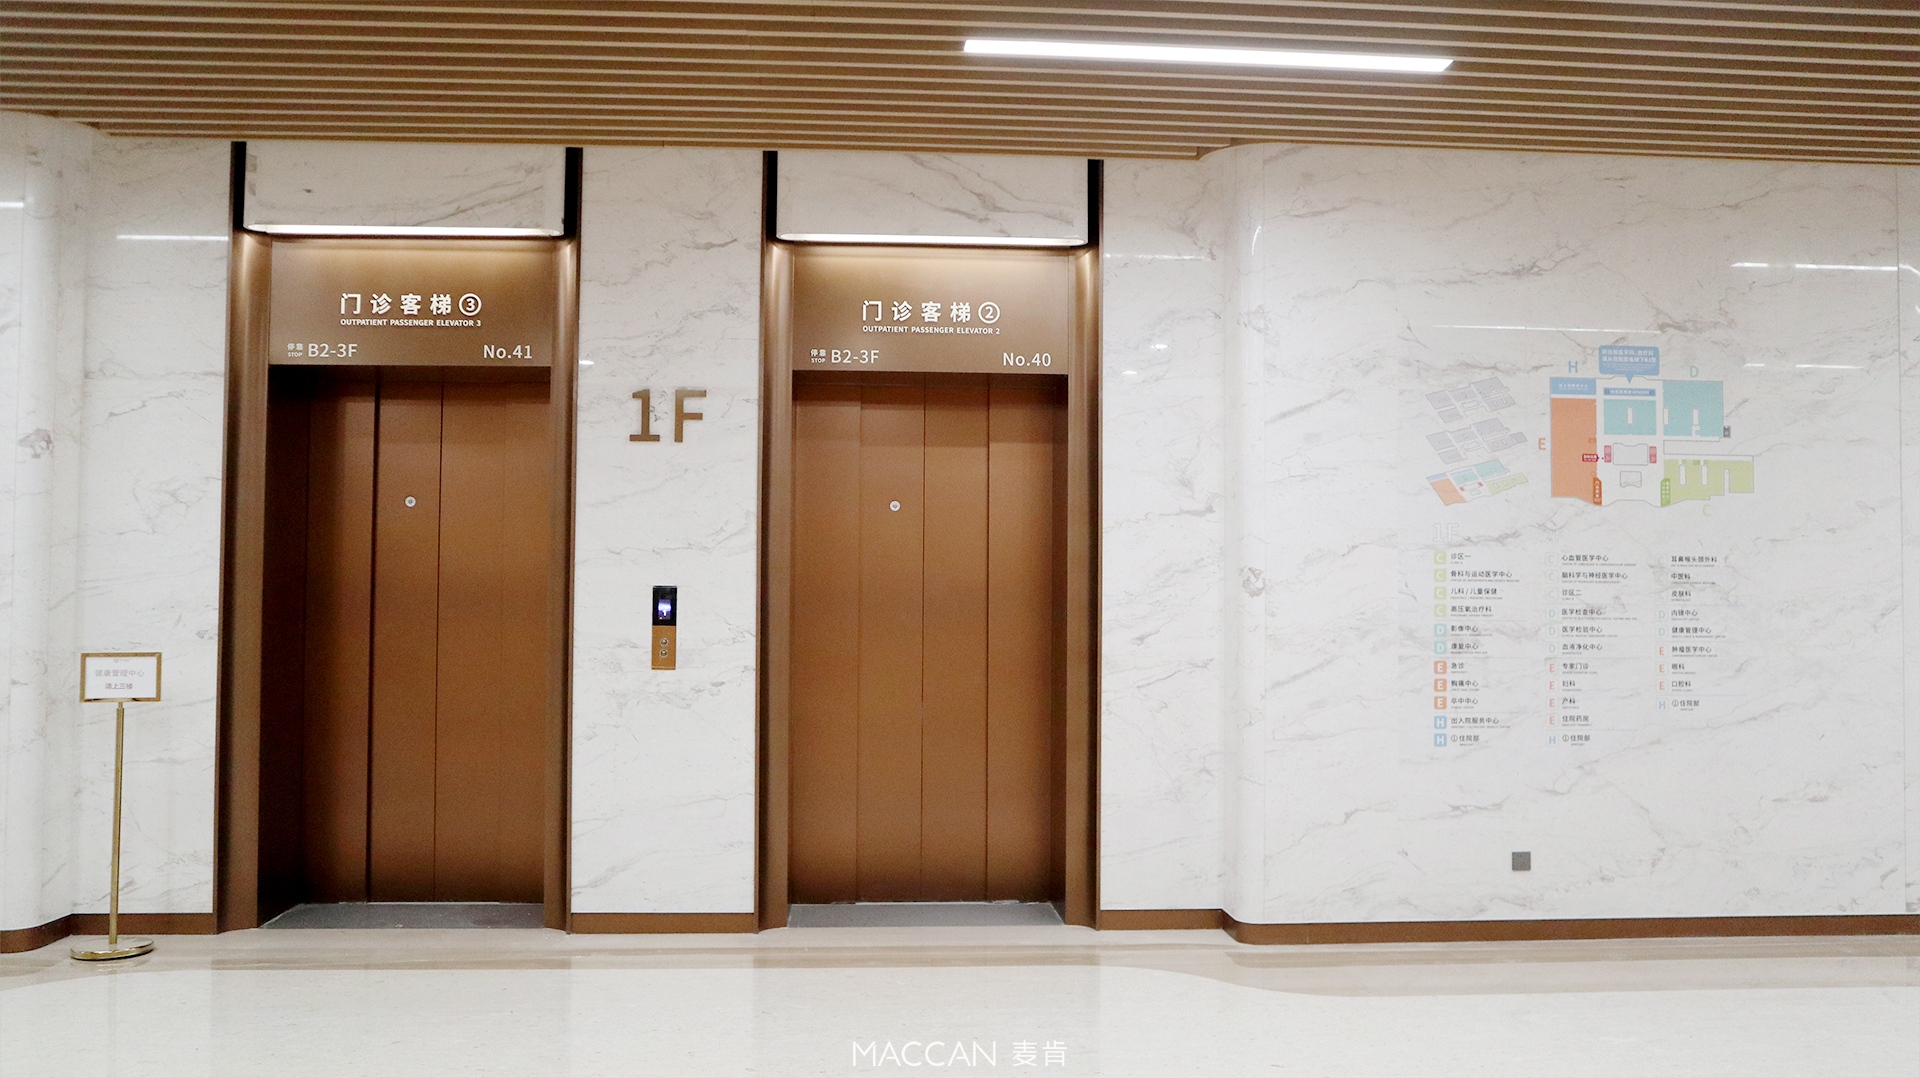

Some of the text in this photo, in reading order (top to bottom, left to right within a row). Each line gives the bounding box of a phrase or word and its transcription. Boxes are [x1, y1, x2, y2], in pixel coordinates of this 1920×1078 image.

[340, 318, 388, 326] OUTPATIENT
[390, 318, 434, 326] PASSENGER
[308, 343, 358, 358] B2-3F
[483, 344, 532, 359] No.41
[831, 350, 880, 364] B2-3F
[1003, 352, 1051, 367] No.40
[1568, 360, 1578, 373] H
[1690, 366, 1698, 378] D
[630, 389, 706, 442] 1F
[1538, 438, 1546, 450] E
